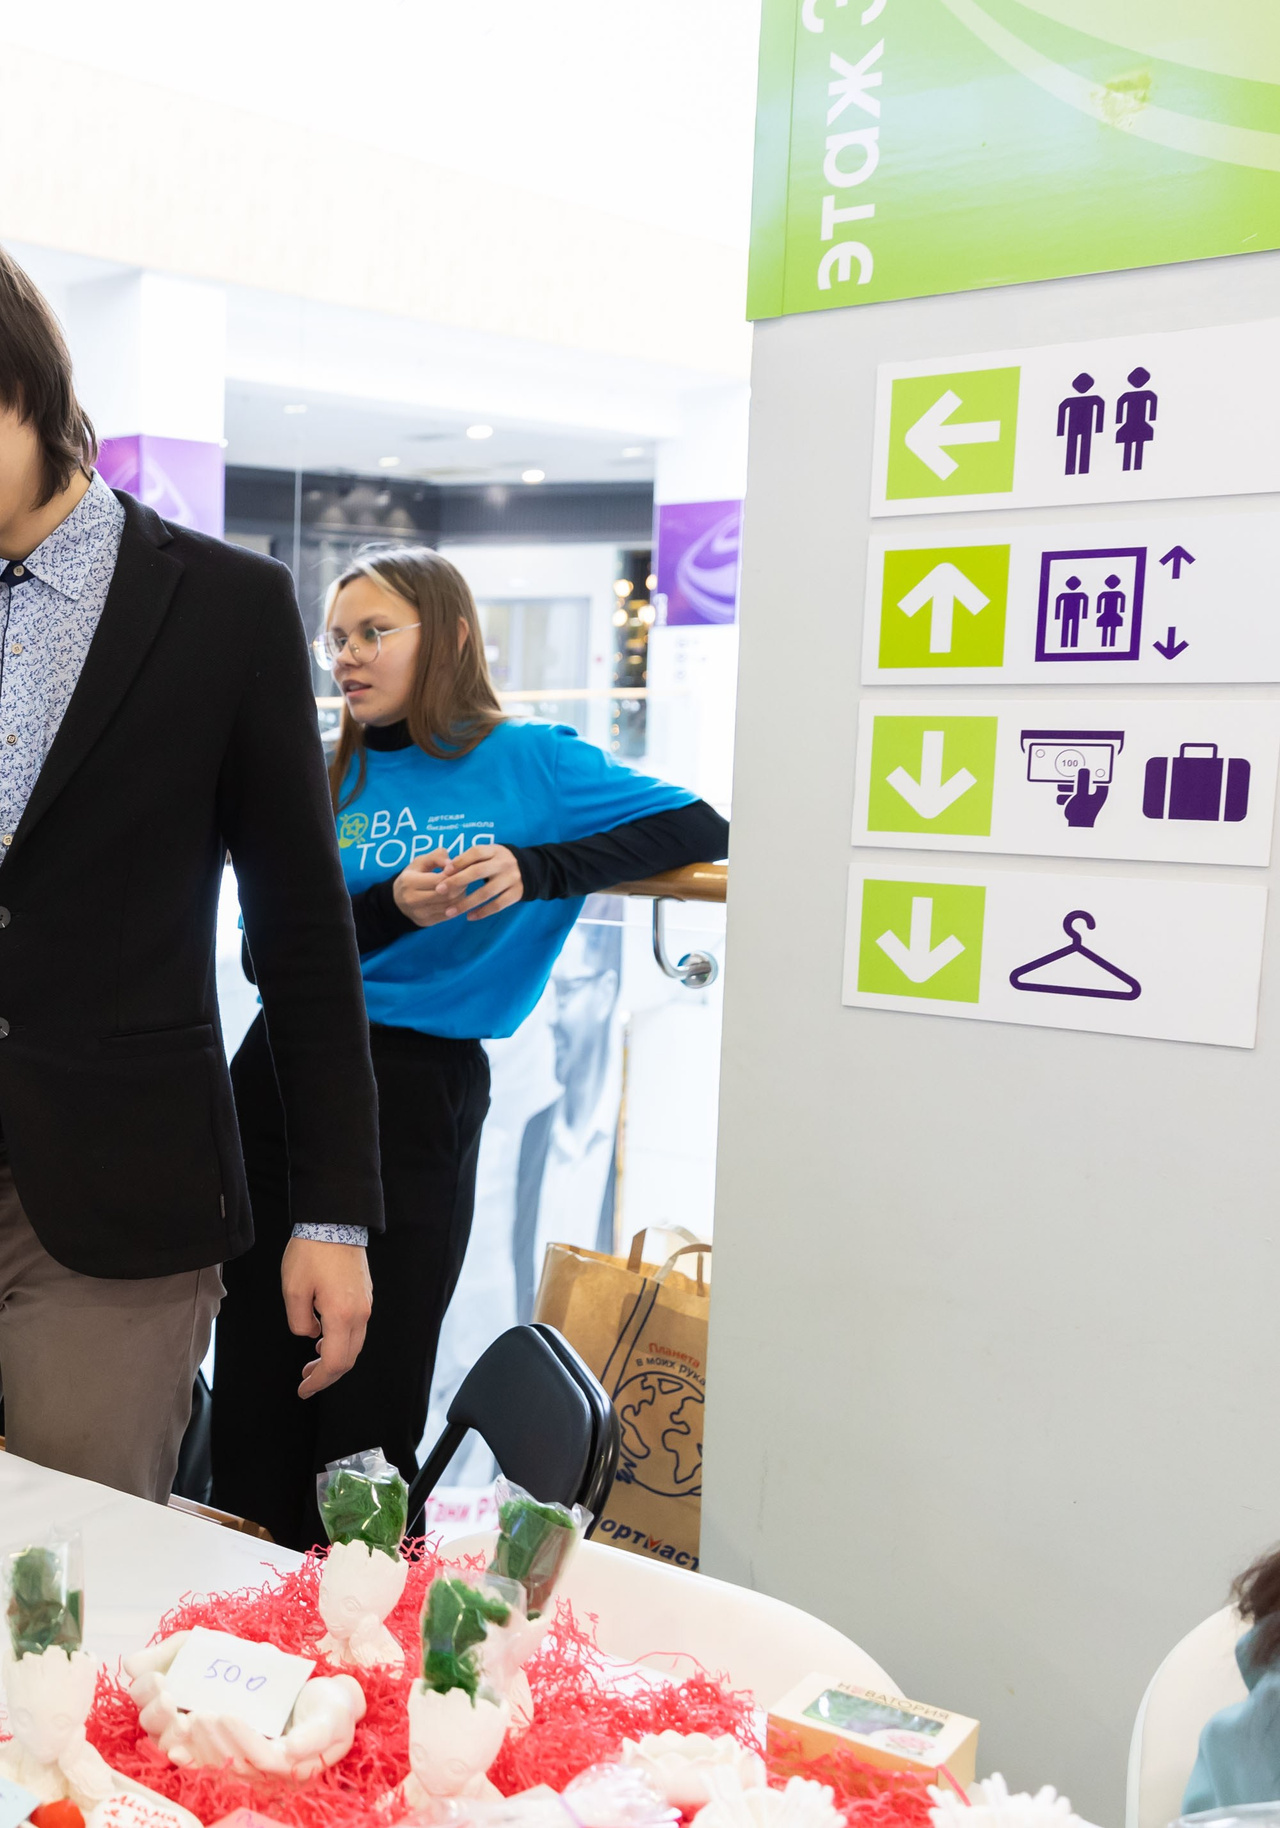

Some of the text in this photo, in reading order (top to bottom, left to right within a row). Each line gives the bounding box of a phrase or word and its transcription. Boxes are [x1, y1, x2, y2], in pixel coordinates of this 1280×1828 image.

[817, 38, 885, 290] этаж
[1061, 759, 1079, 768] 100
[646, 1356, 677, 1370] моих
[648, 1341, 701, 1369] Планета
[203, 1658, 267, 1692] 500
